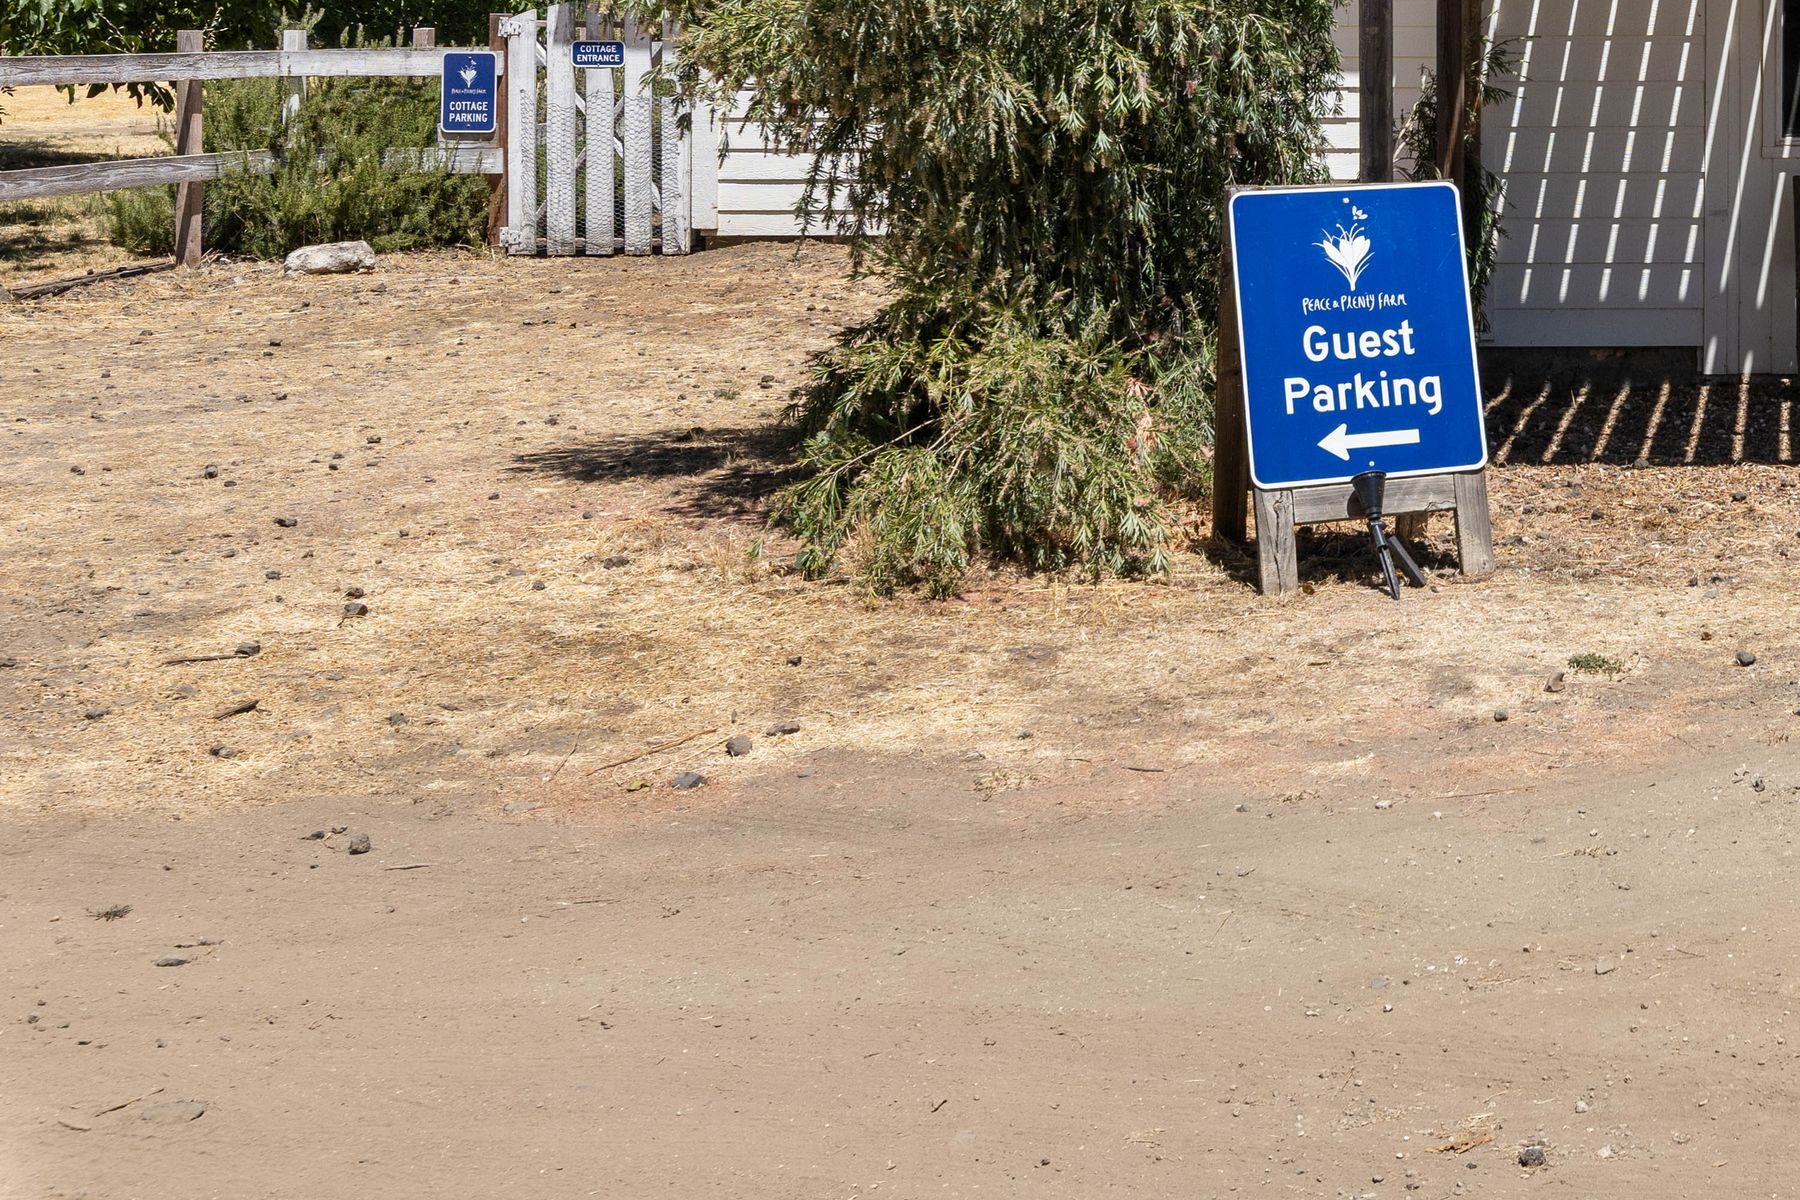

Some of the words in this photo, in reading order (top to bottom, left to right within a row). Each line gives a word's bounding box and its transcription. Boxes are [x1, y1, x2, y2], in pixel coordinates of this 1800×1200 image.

[580, 45, 617, 53] COTTAGE
[576, 54, 620, 62] ENTRANCE
[449, 101, 488, 111] COTTAGE
[449, 113, 488, 123] PARKING
[1302, 297, 1331, 316] PEACE
[1332, 299, 1340, 309] &
[1340, 293, 1375, 312] PLENTY
[1378, 292, 1408, 310] FARM
[1303, 319, 1415, 362] Guest
[1284, 370, 1443, 416] Parking
